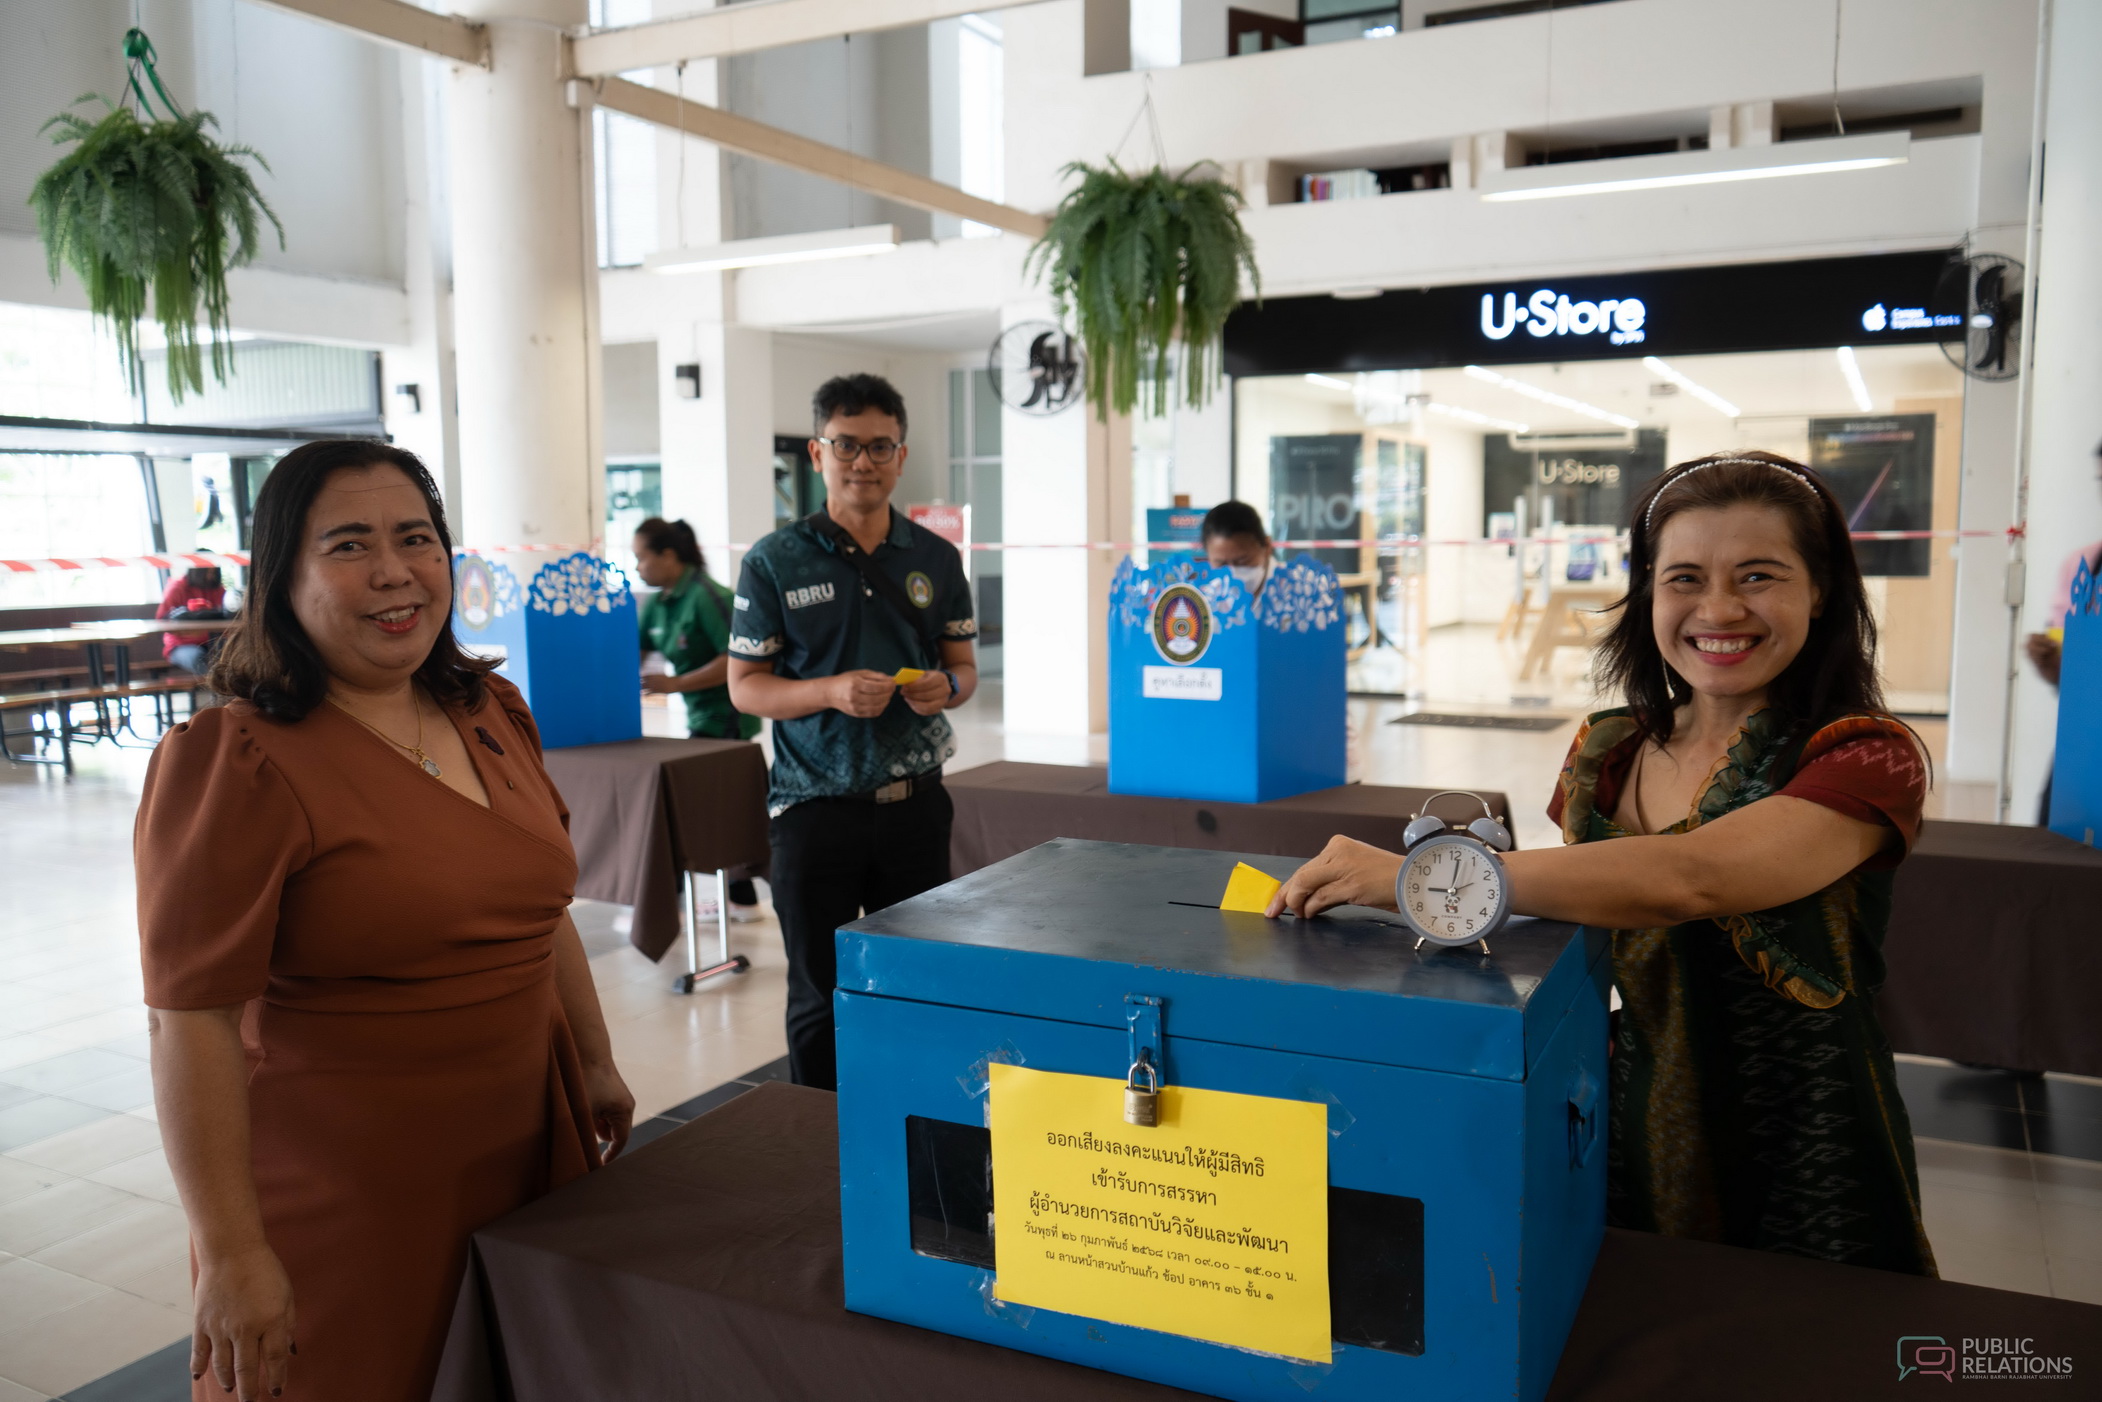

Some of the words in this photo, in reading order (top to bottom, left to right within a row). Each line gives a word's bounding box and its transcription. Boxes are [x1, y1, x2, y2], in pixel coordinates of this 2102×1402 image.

[785, 582, 835, 608] RBRU
[1432, 854, 1442, 864] 11
[1450, 850, 1462, 861] 12
[1418, 866, 1432, 876] 10
[1484, 870, 1491, 881] 2
[1412, 883, 1420, 893] 9
[1488, 889, 1495, 900] 3
[1416, 902, 1424, 912] 8
[1479, 908, 1488, 918] 4
[1432, 916, 1438, 926] 7
[1466, 920, 1474, 930] 5
[1448, 922, 1455, 932] 6
[1047, 1132, 1265, 1177] ออกเสียงลงคะแนนให้ผู้มีสิทธิ
[1092, 1168, 1217, 1206] เข้ารับการสรรหา
[1030, 1191, 1289, 1254] ผู้อำนวยการสถาบันวิจัยและพัฒนา
[1024, 1221, 1058, 1239] วันพุธที่
[1061, 1231, 1077, 1241] ๒๖
[1080, 1235, 1128, 1251] กุมภาพันธ์
[1167, 1250, 1190, 1262] เวลา
[1286, 1271, 1297, 1282] น.
[1046, 1250, 1055, 1260] ณ
[1059, 1253, 1159, 1279] ลานหน้าสวนบ้านแก้ว
[1189, 1277, 1220, 1291] อาคาร
[1245, 1281, 1261, 1298] ชั้น
